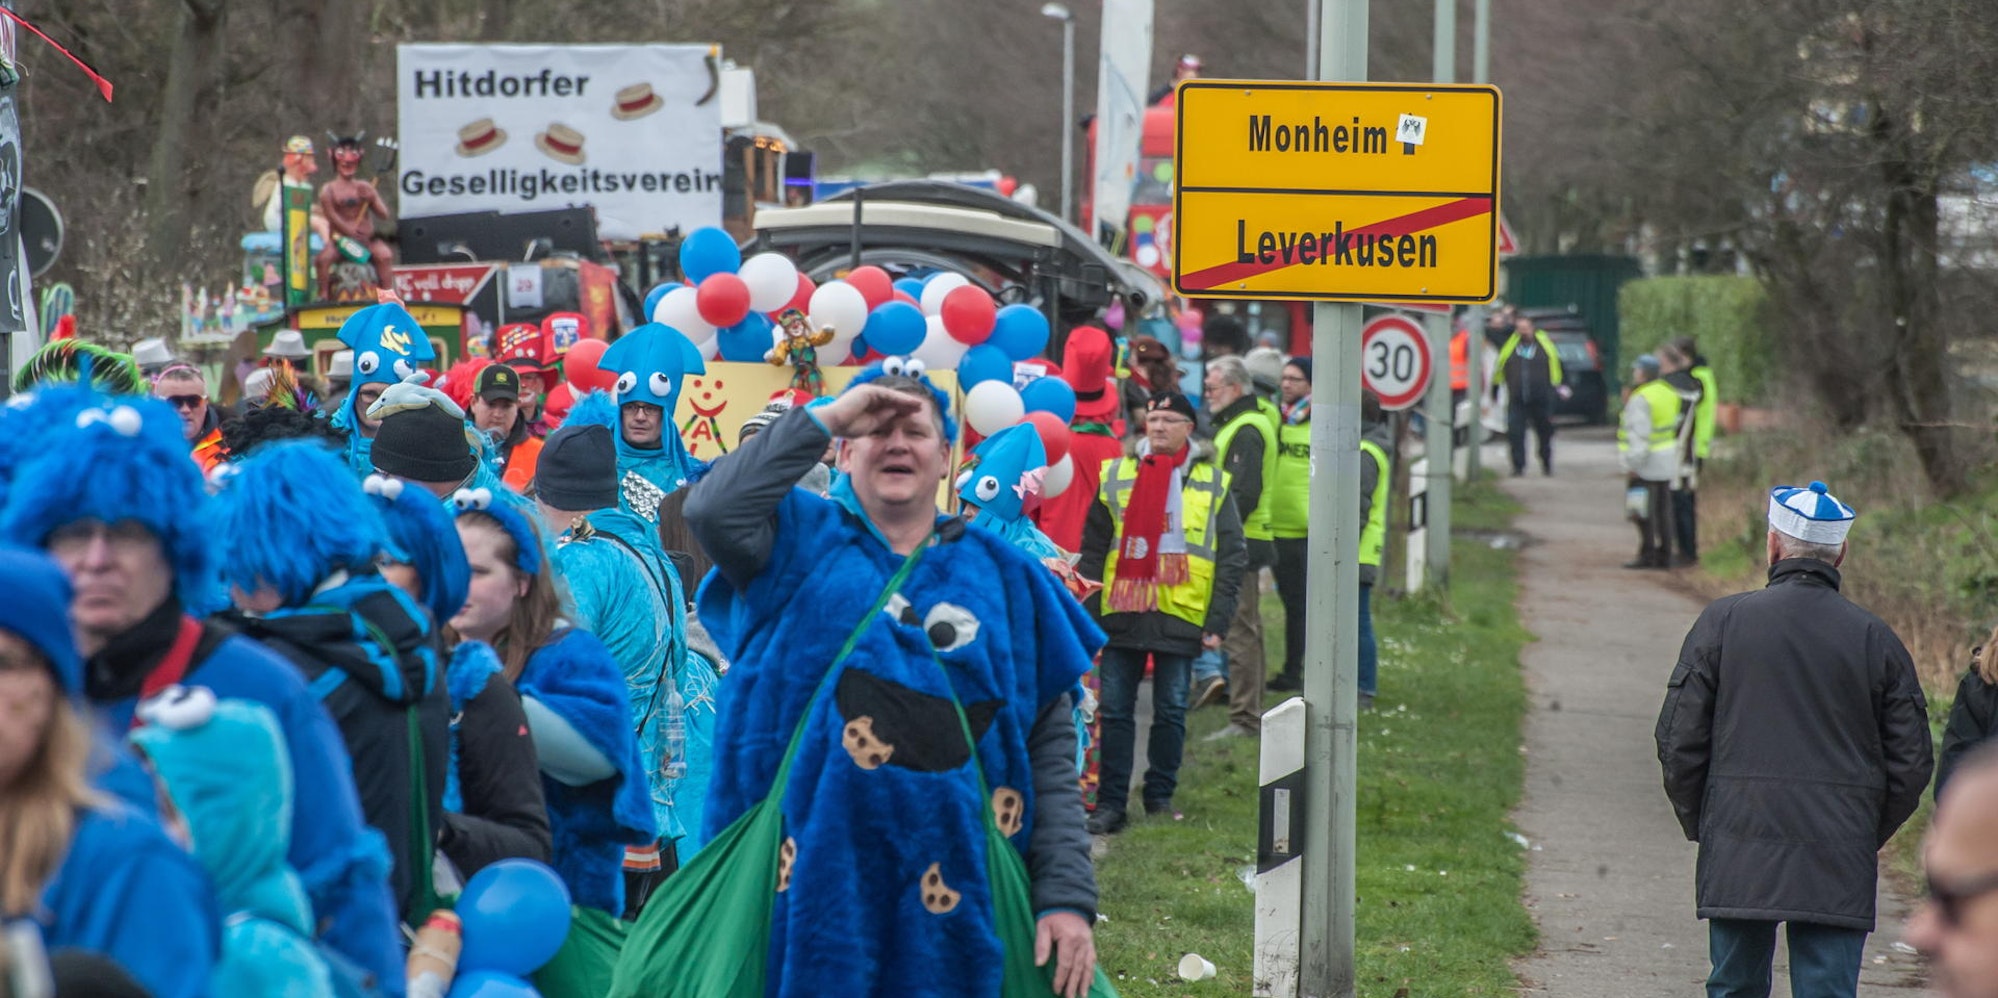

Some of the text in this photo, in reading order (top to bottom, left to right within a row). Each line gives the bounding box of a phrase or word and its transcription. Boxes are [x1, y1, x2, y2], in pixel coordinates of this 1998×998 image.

[414, 68, 590, 98] Hitdorfer
[1248, 114, 1388, 155] Monheim
[402, 167, 723, 201] Geselligkeitsverein
[1236, 219, 1438, 268] Leverkusen
[1369, 341, 1414, 383] 30
